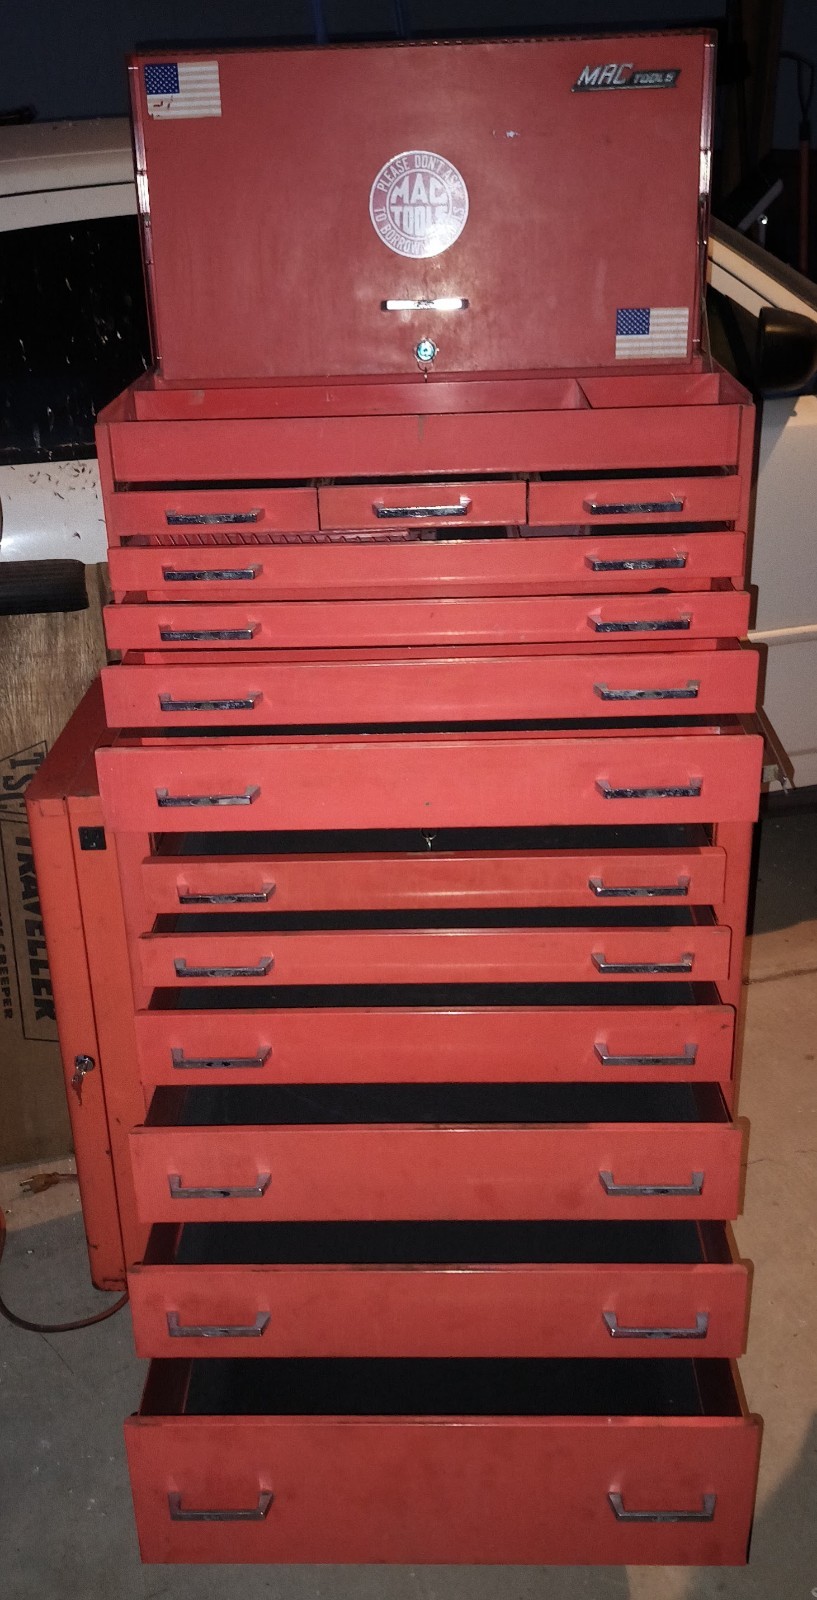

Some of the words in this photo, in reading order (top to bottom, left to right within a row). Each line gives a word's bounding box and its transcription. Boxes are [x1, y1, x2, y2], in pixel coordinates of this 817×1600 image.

[577, 63, 633, 85] MAC
[633, 72, 674, 84] TOOLS
[377, 157, 410, 193] PLEASE
[414, 154, 445, 175] DON'T
[390, 172, 448, 205] MAC
[374, 206, 388, 222] TO
[391, 205, 449, 237] TOOLS
